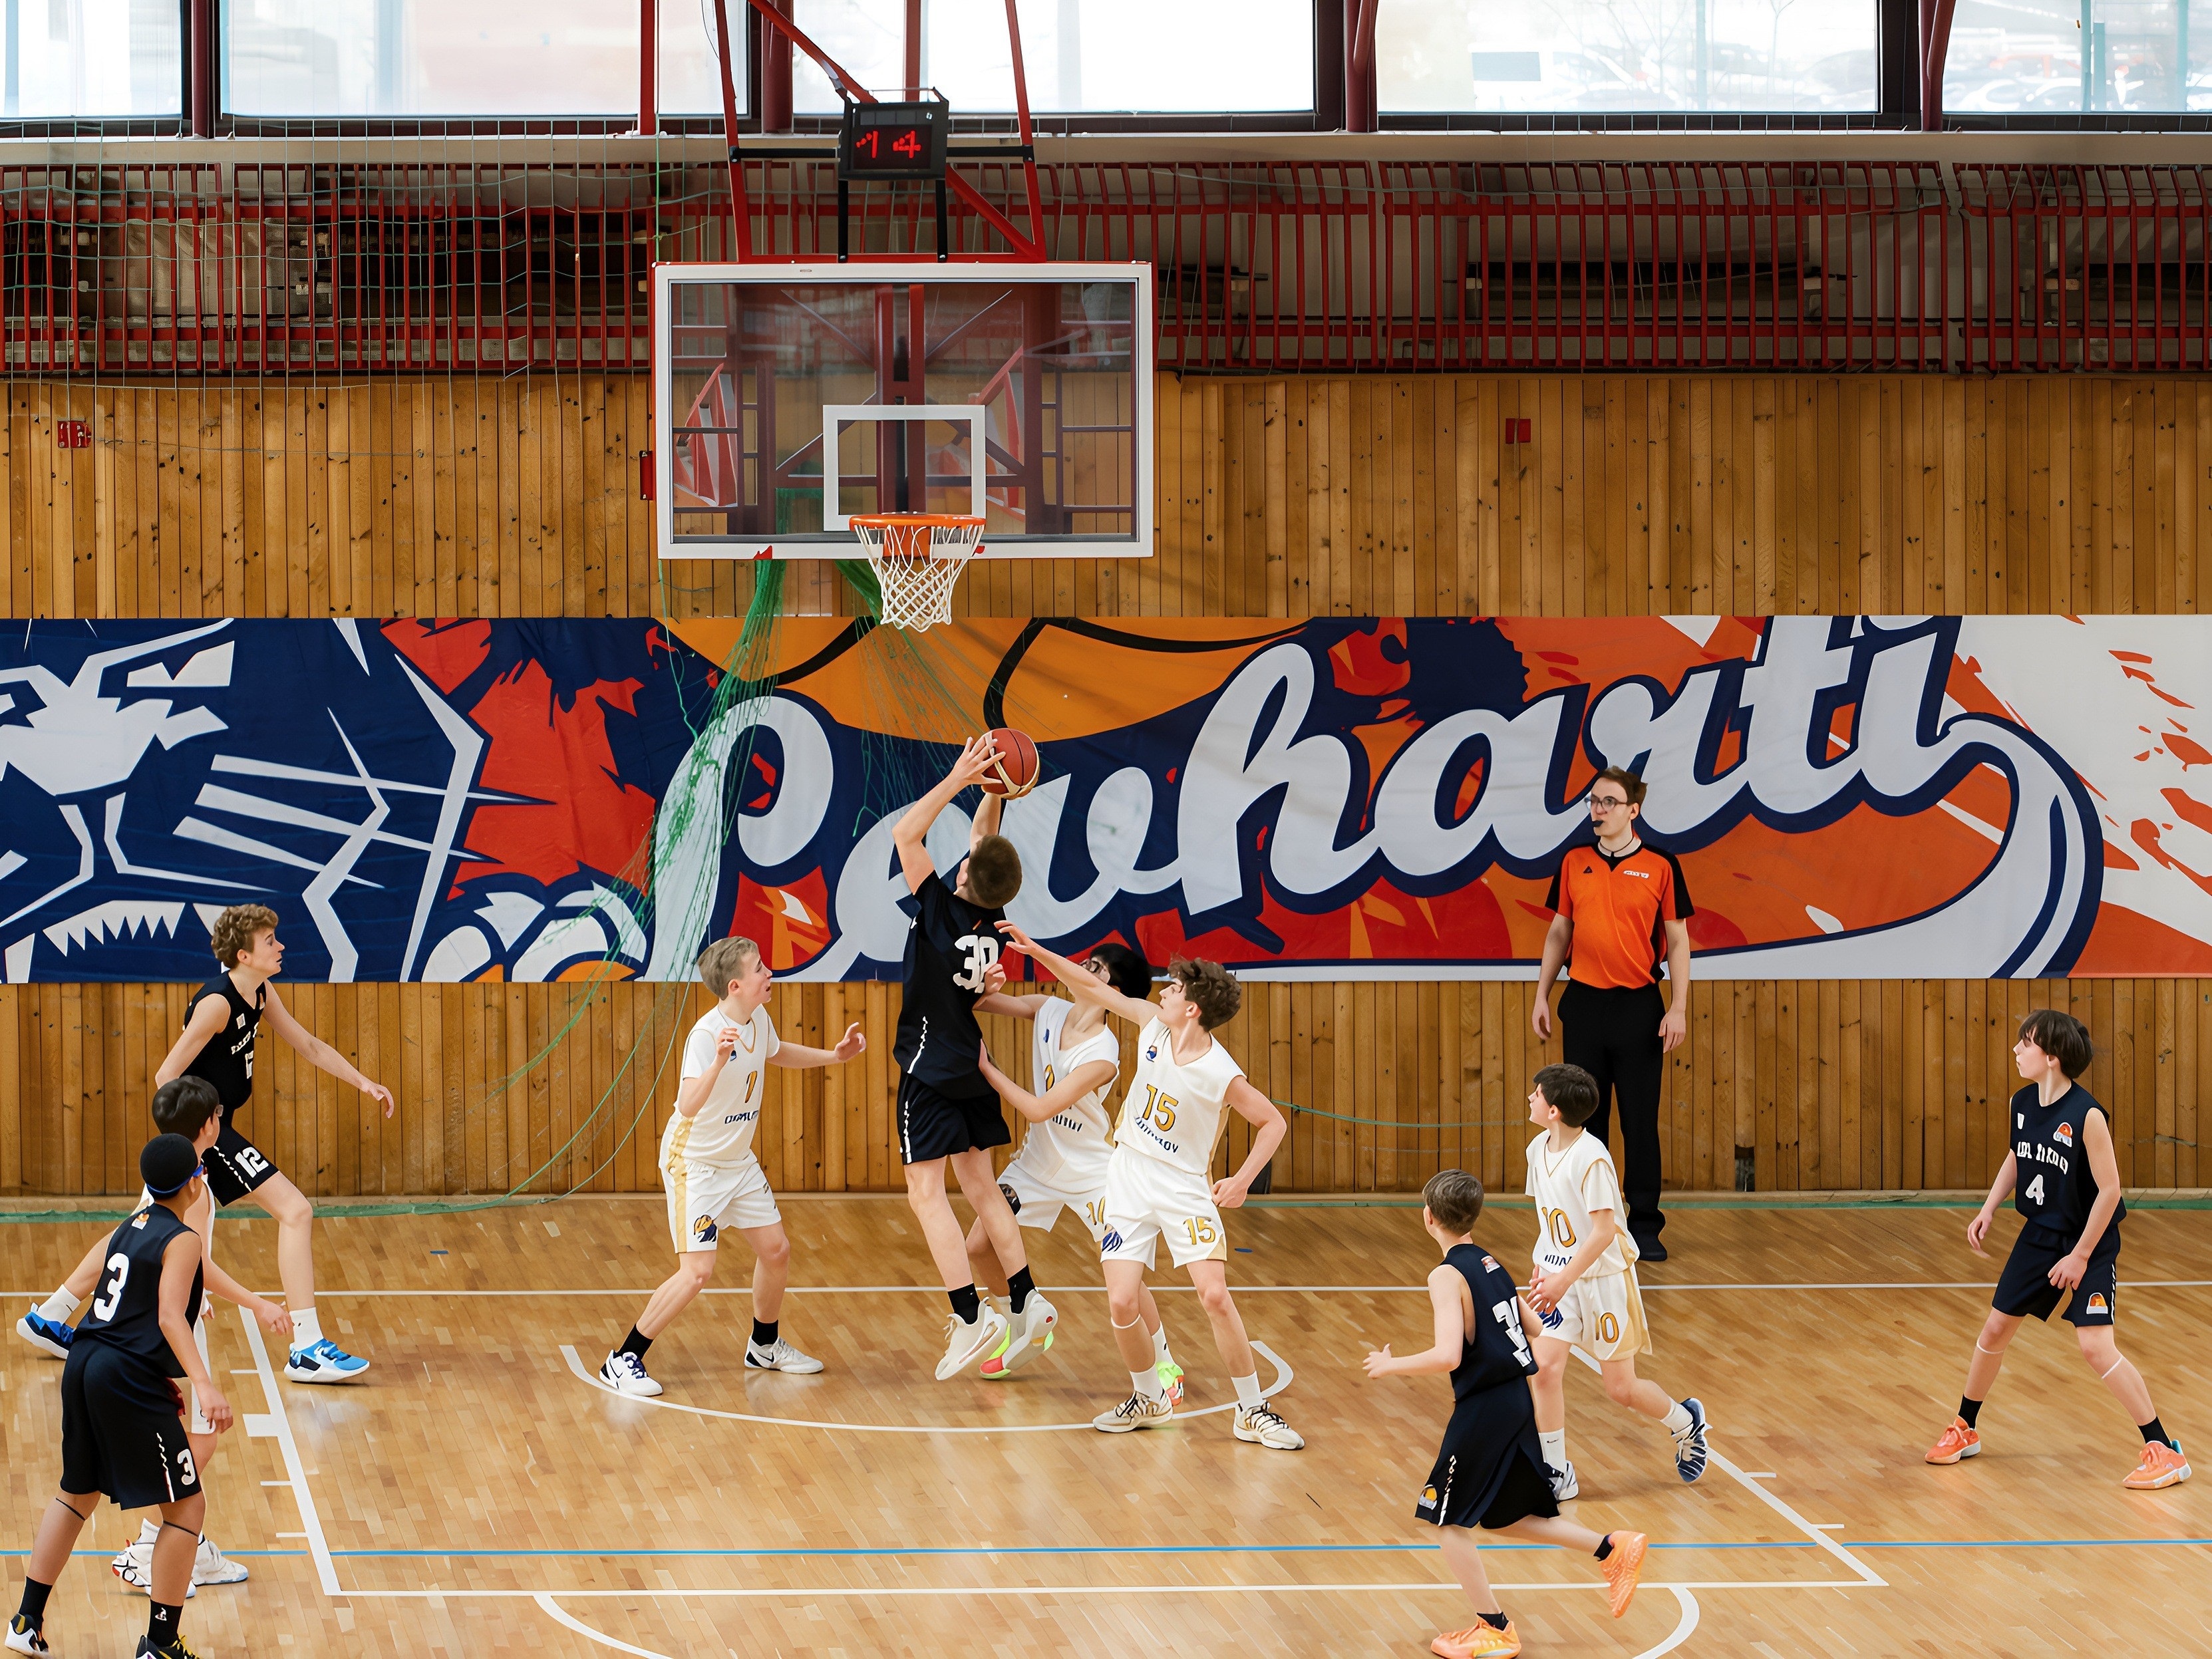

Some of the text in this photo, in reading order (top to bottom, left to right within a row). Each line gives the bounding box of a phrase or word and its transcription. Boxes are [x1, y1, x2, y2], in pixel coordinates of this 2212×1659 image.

[856, 130, 922, 158] 14
[1142, 1083, 1180, 1131] 15
[235, 1146, 269, 1178] 12
[2025, 1173, 2045, 1206] 4
[1183, 1216, 1216, 1245] 15
[93, 1252, 130, 1322] 3
[1592, 1305, 1619, 1344] 10
[177, 1448, 196, 1485] 3
